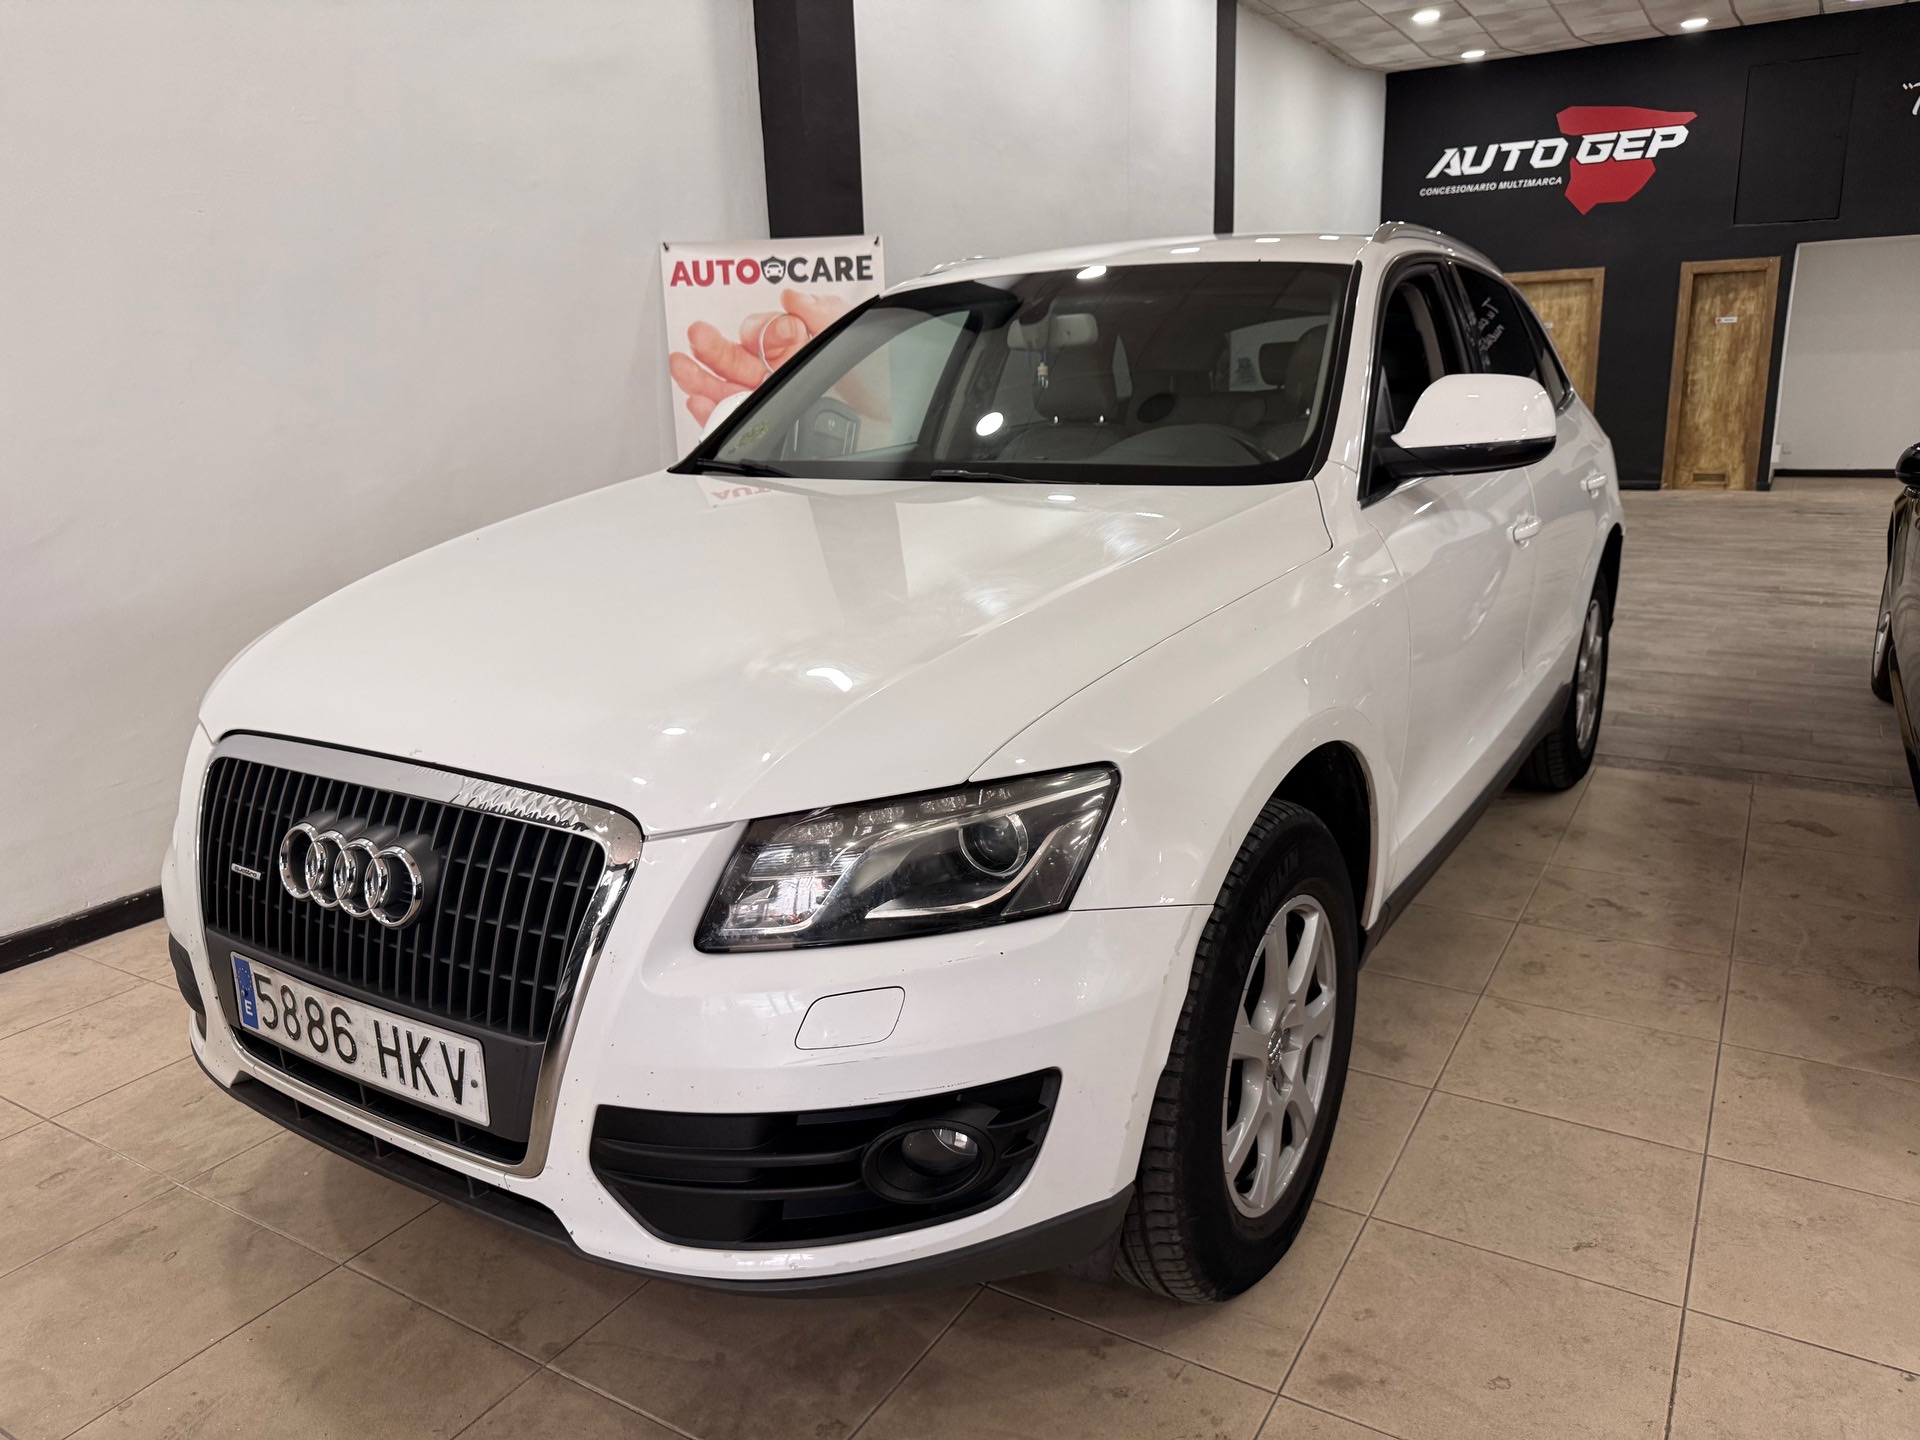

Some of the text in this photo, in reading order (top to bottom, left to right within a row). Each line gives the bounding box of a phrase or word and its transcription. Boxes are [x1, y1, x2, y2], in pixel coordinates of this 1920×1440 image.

[1425, 125, 1689, 179] AUTO GEP
[1419, 176, 1562, 197] CONCESIONARIO MULTIMARCA
[670, 255, 874, 287] AUTO CARE
[234, 866, 258, 878] quattro
[245, 1000, 254, 1017] E
[253, 972, 466, 1106] 5886 HKV
